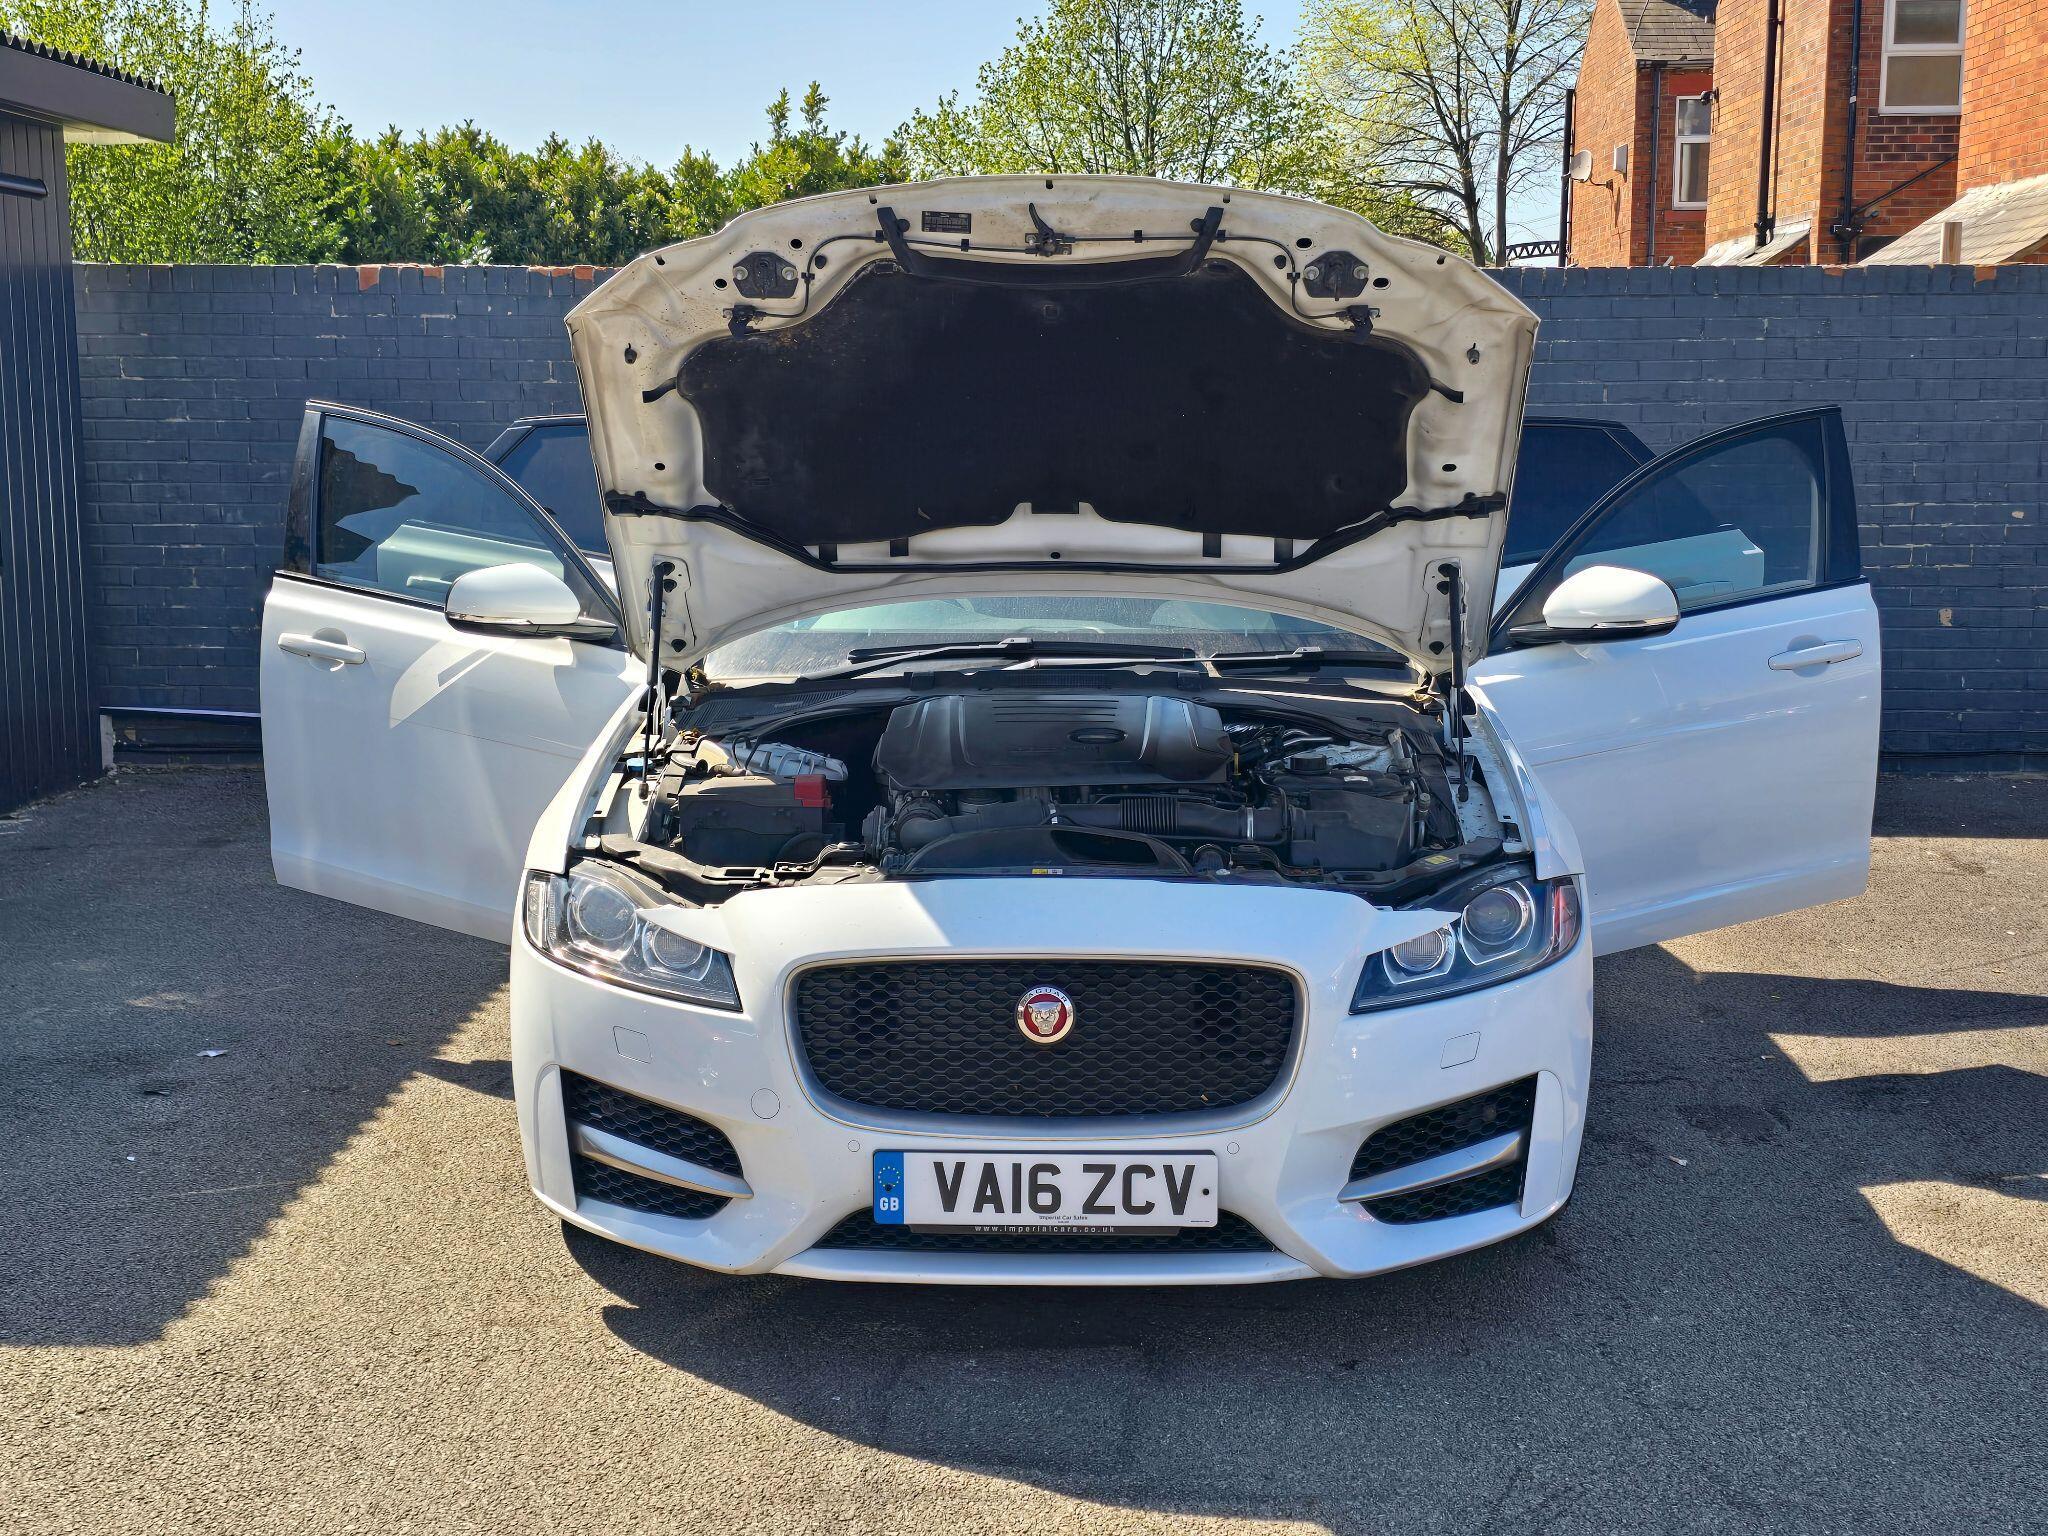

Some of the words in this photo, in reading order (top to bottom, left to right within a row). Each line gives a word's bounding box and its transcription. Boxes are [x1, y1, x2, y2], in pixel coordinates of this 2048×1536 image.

[933, 1162, 1062, 1214] VA16
[1082, 1164, 1196, 1215] ZCV
[879, 1196, 900, 1212] GB
[974, 1225, 1115, 1234] www.imperialcars.co.uk
